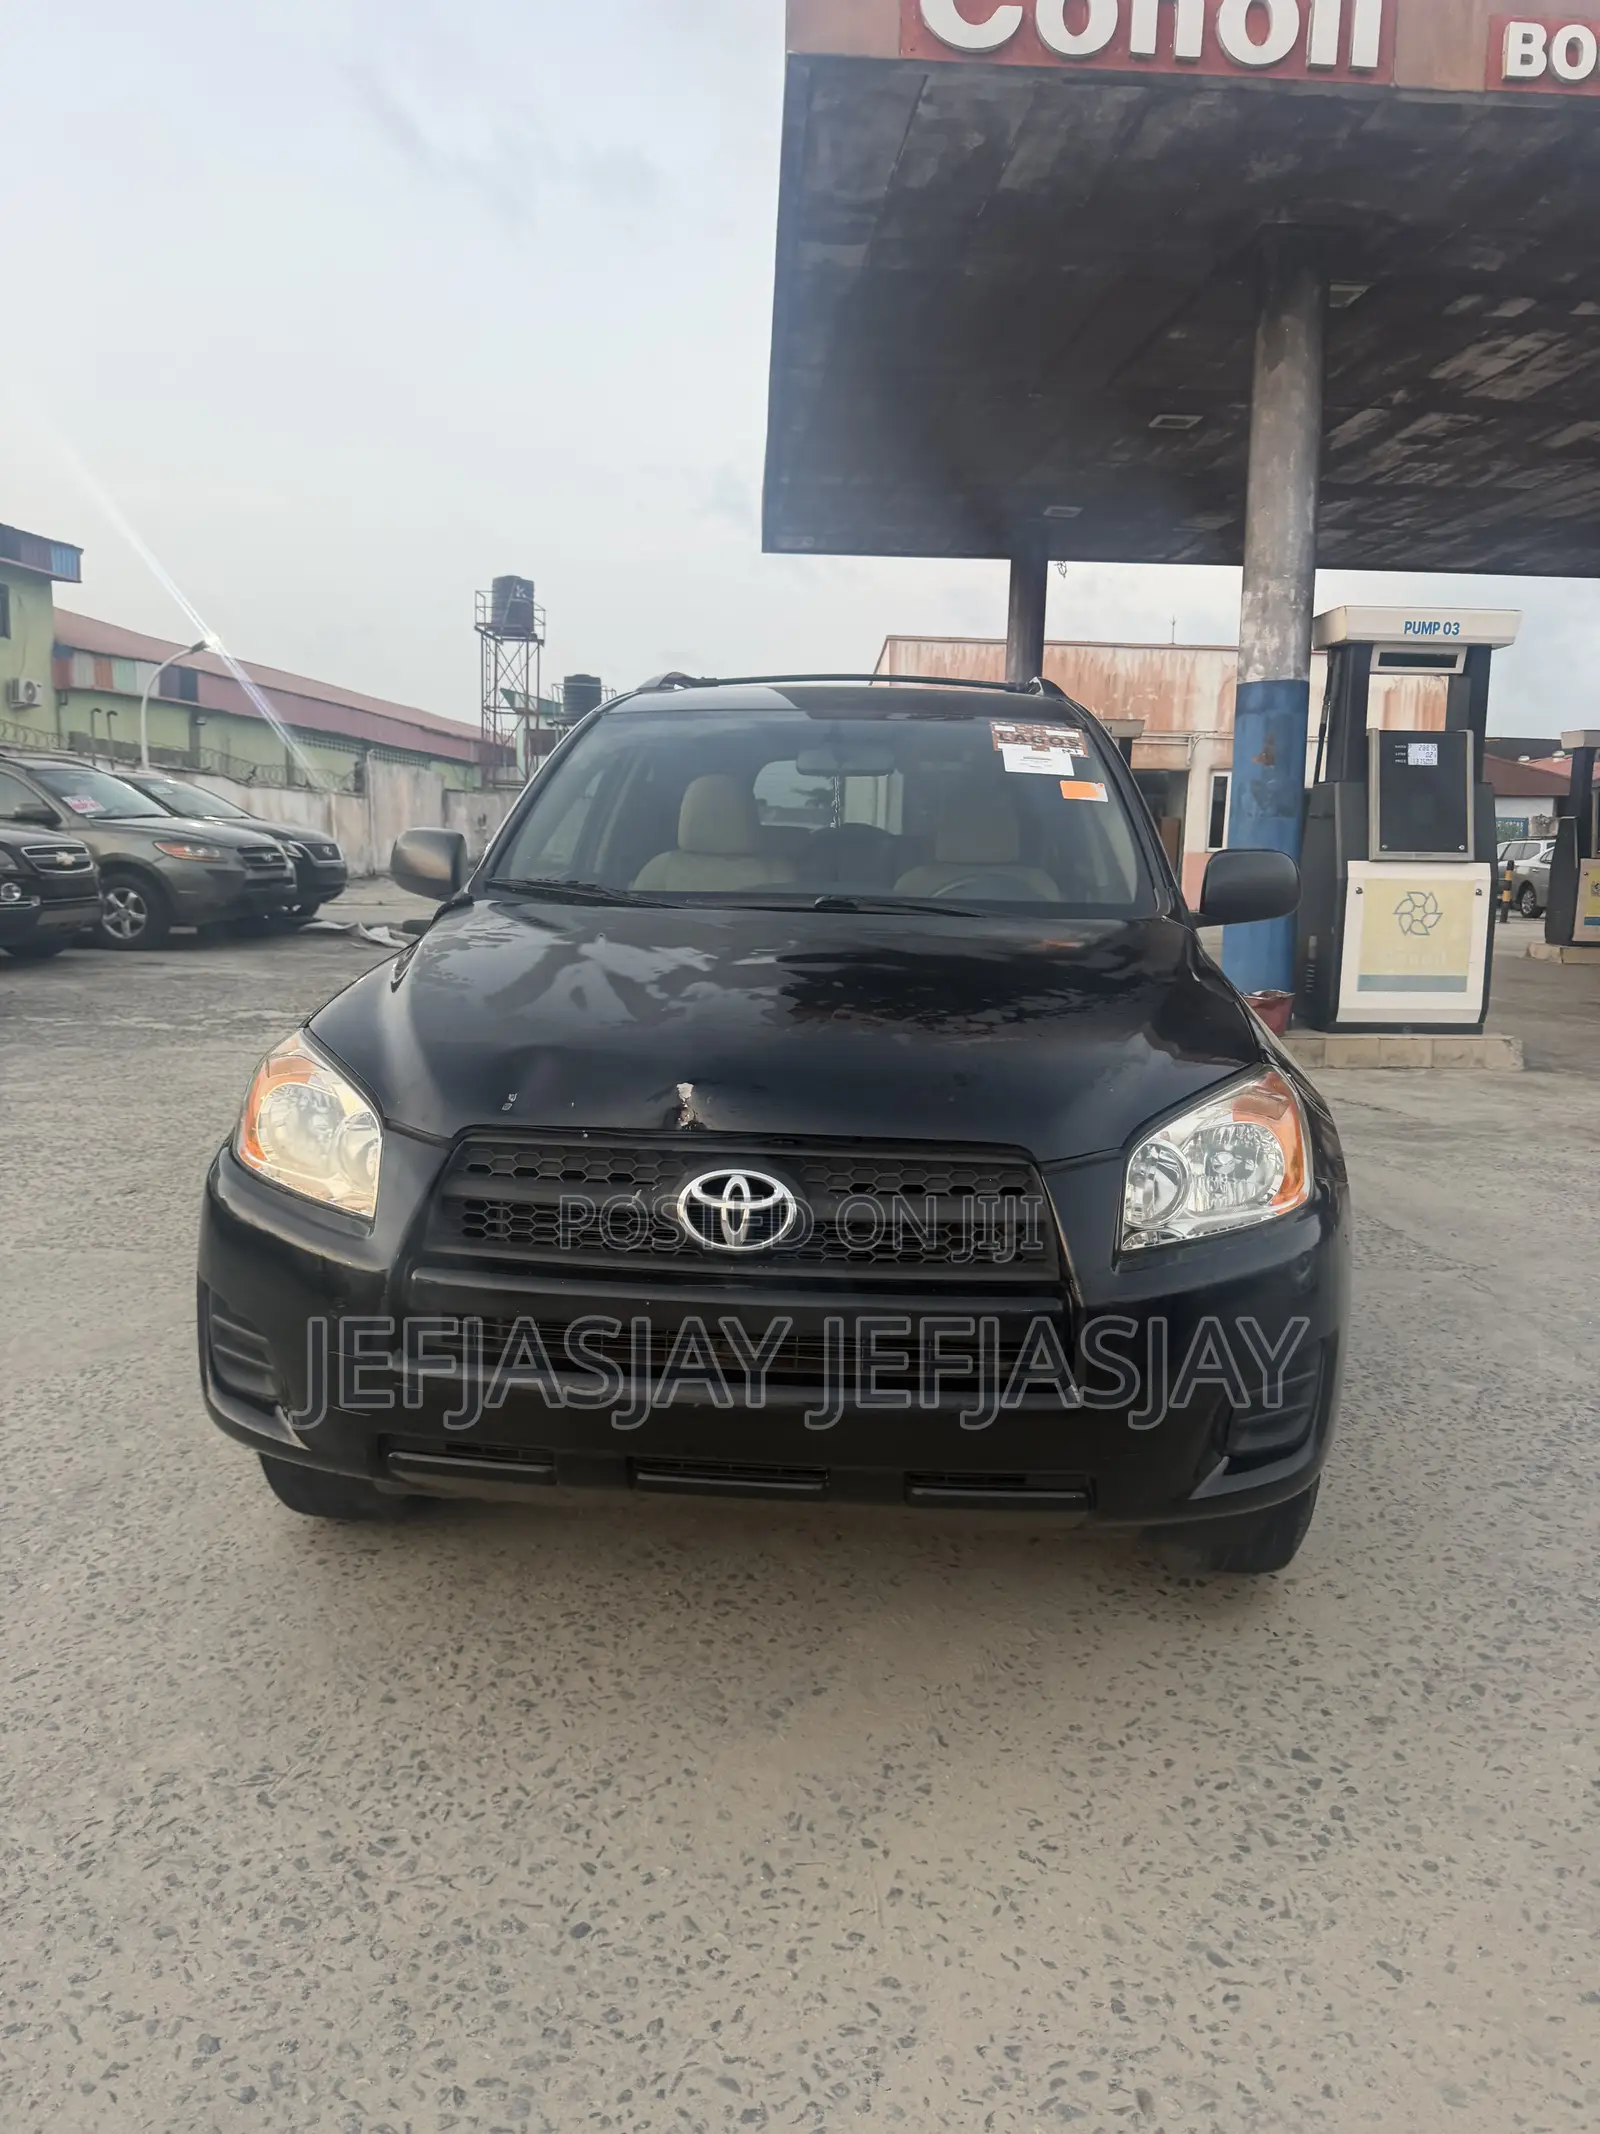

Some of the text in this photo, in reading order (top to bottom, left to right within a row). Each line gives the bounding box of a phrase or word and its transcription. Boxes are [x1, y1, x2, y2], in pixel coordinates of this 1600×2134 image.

[1502, 21, 1600, 81] BO
[1403, 620, 1460, 636] PUMP 03
